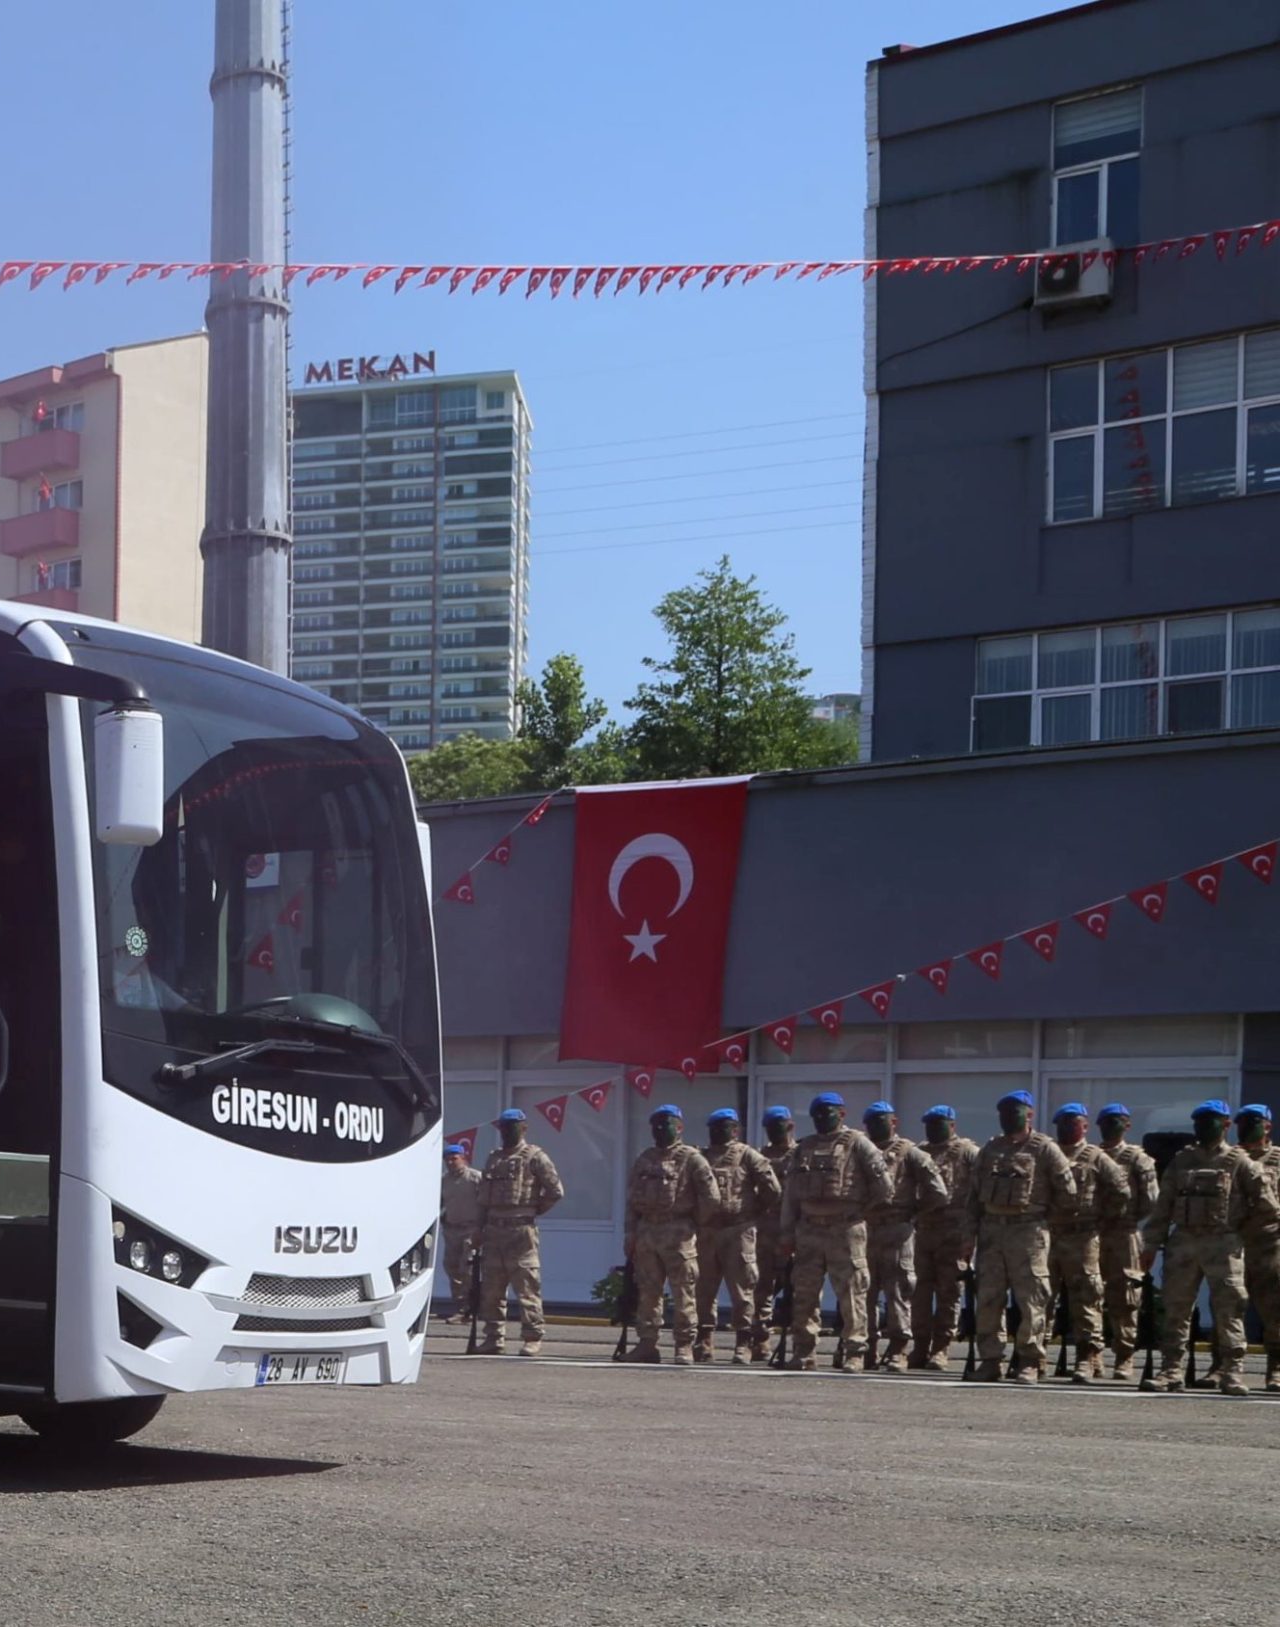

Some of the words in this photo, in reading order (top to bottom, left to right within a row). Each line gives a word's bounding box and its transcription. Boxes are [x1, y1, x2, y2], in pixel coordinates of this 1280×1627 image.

[304, 350, 436, 384] MEKAN
[212, 1077, 317, 1135] GİRESUN
[334, 1101, 384, 1144] ORDU
[274, 1226, 358, 1254] ISUZU
[267, 1357, 283, 1381] 28
